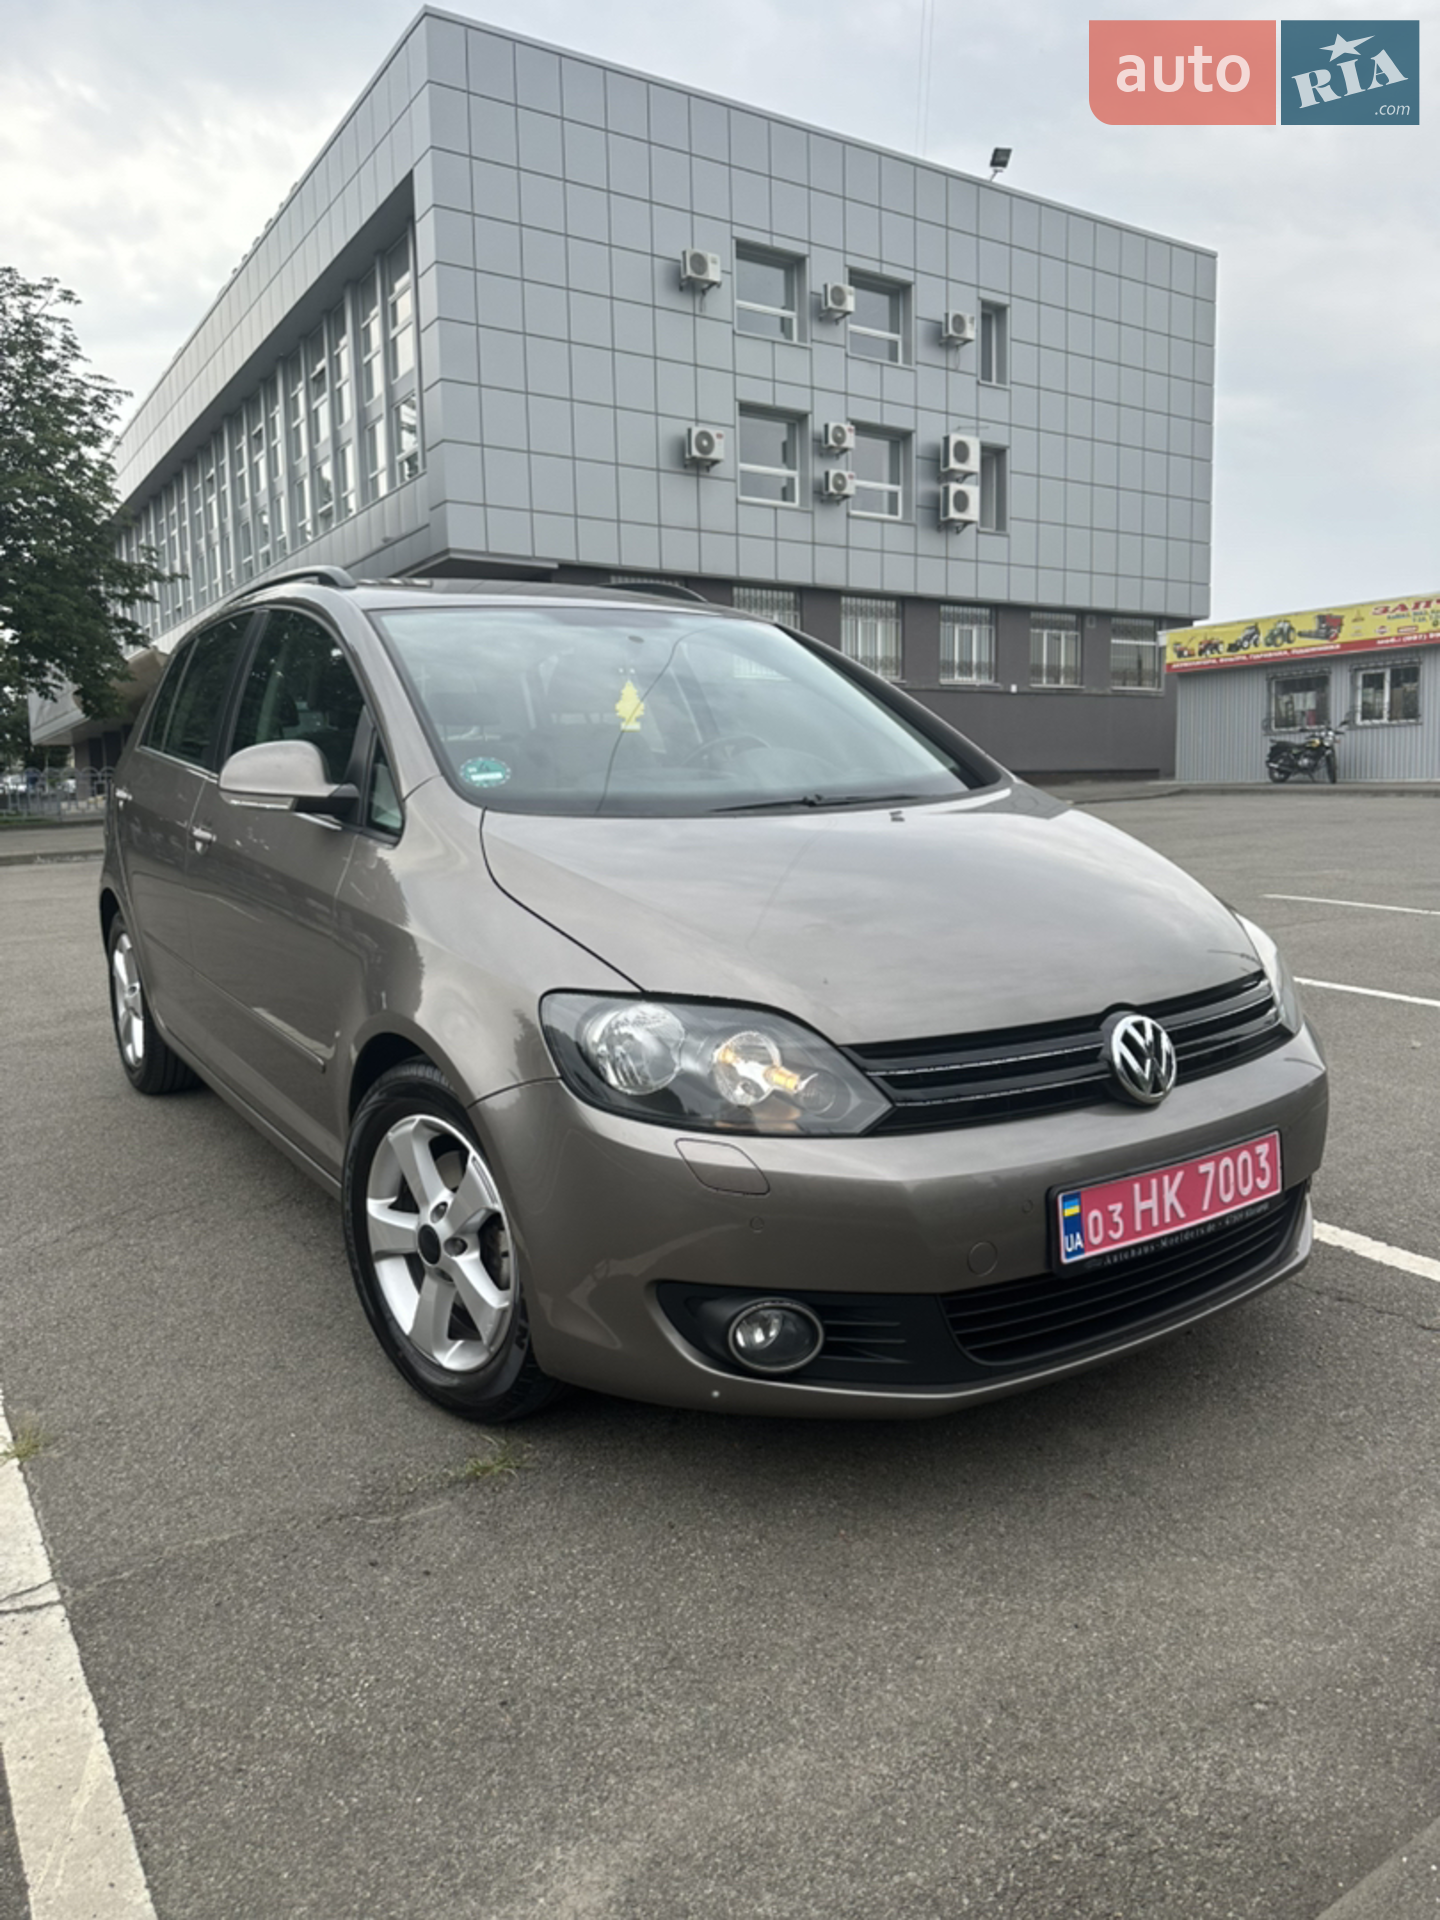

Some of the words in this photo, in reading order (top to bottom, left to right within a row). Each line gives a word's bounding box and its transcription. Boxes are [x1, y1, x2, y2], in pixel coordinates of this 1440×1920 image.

[1087, 1202, 1125, 1246] 03
[1133, 1170, 1186, 1232] HK
[1198, 1142, 1272, 1212] 7003
[1064, 1233, 1084, 1253] UA
